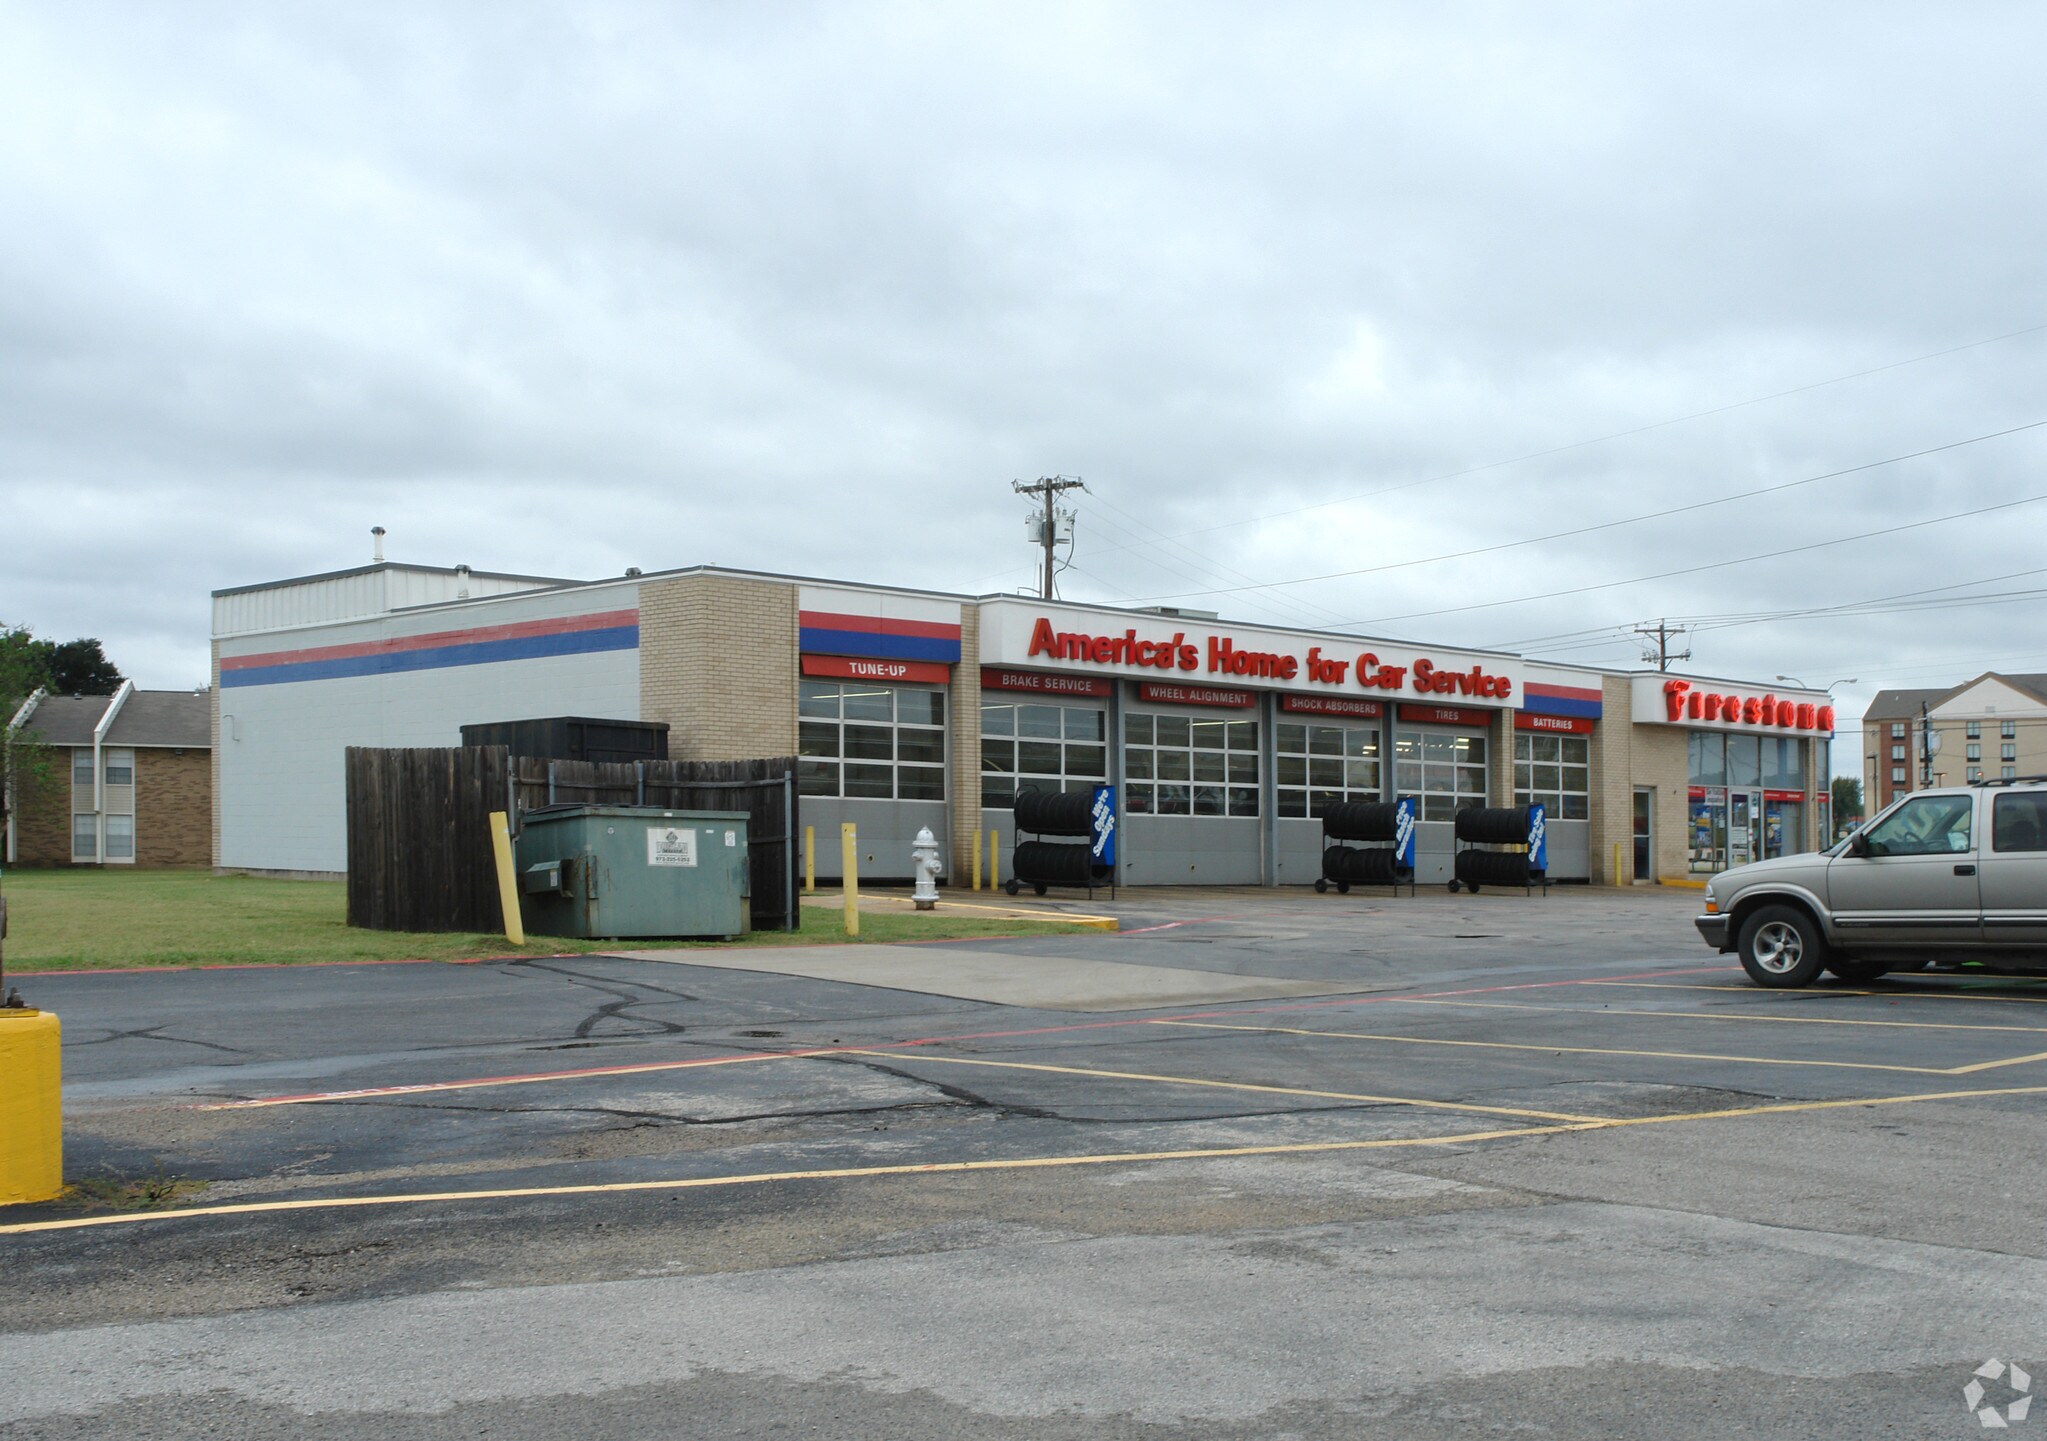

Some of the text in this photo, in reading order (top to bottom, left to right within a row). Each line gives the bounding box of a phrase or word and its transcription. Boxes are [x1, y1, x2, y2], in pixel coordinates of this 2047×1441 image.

[1028, 617, 1511, 698] America's Home for Car Service
[849, 662, 907, 677] TUNE-UP
[1002, 674, 1092, 692] BRAKE SERVICE
[1149, 686, 1248, 705] WHEEL ALIGNMENT
[1664, 679, 1835, 731] Firestone
[1291, 698, 1377, 714] SHOCK ABSORBERS
[1435, 710, 1459, 721] TIRES
[1533, 717, 1573, 730] BATTERIES
[1092, 789, 1109, 818] We're
[1094, 805, 1110, 832] Open
[1093, 815, 1115, 857] Sundays
